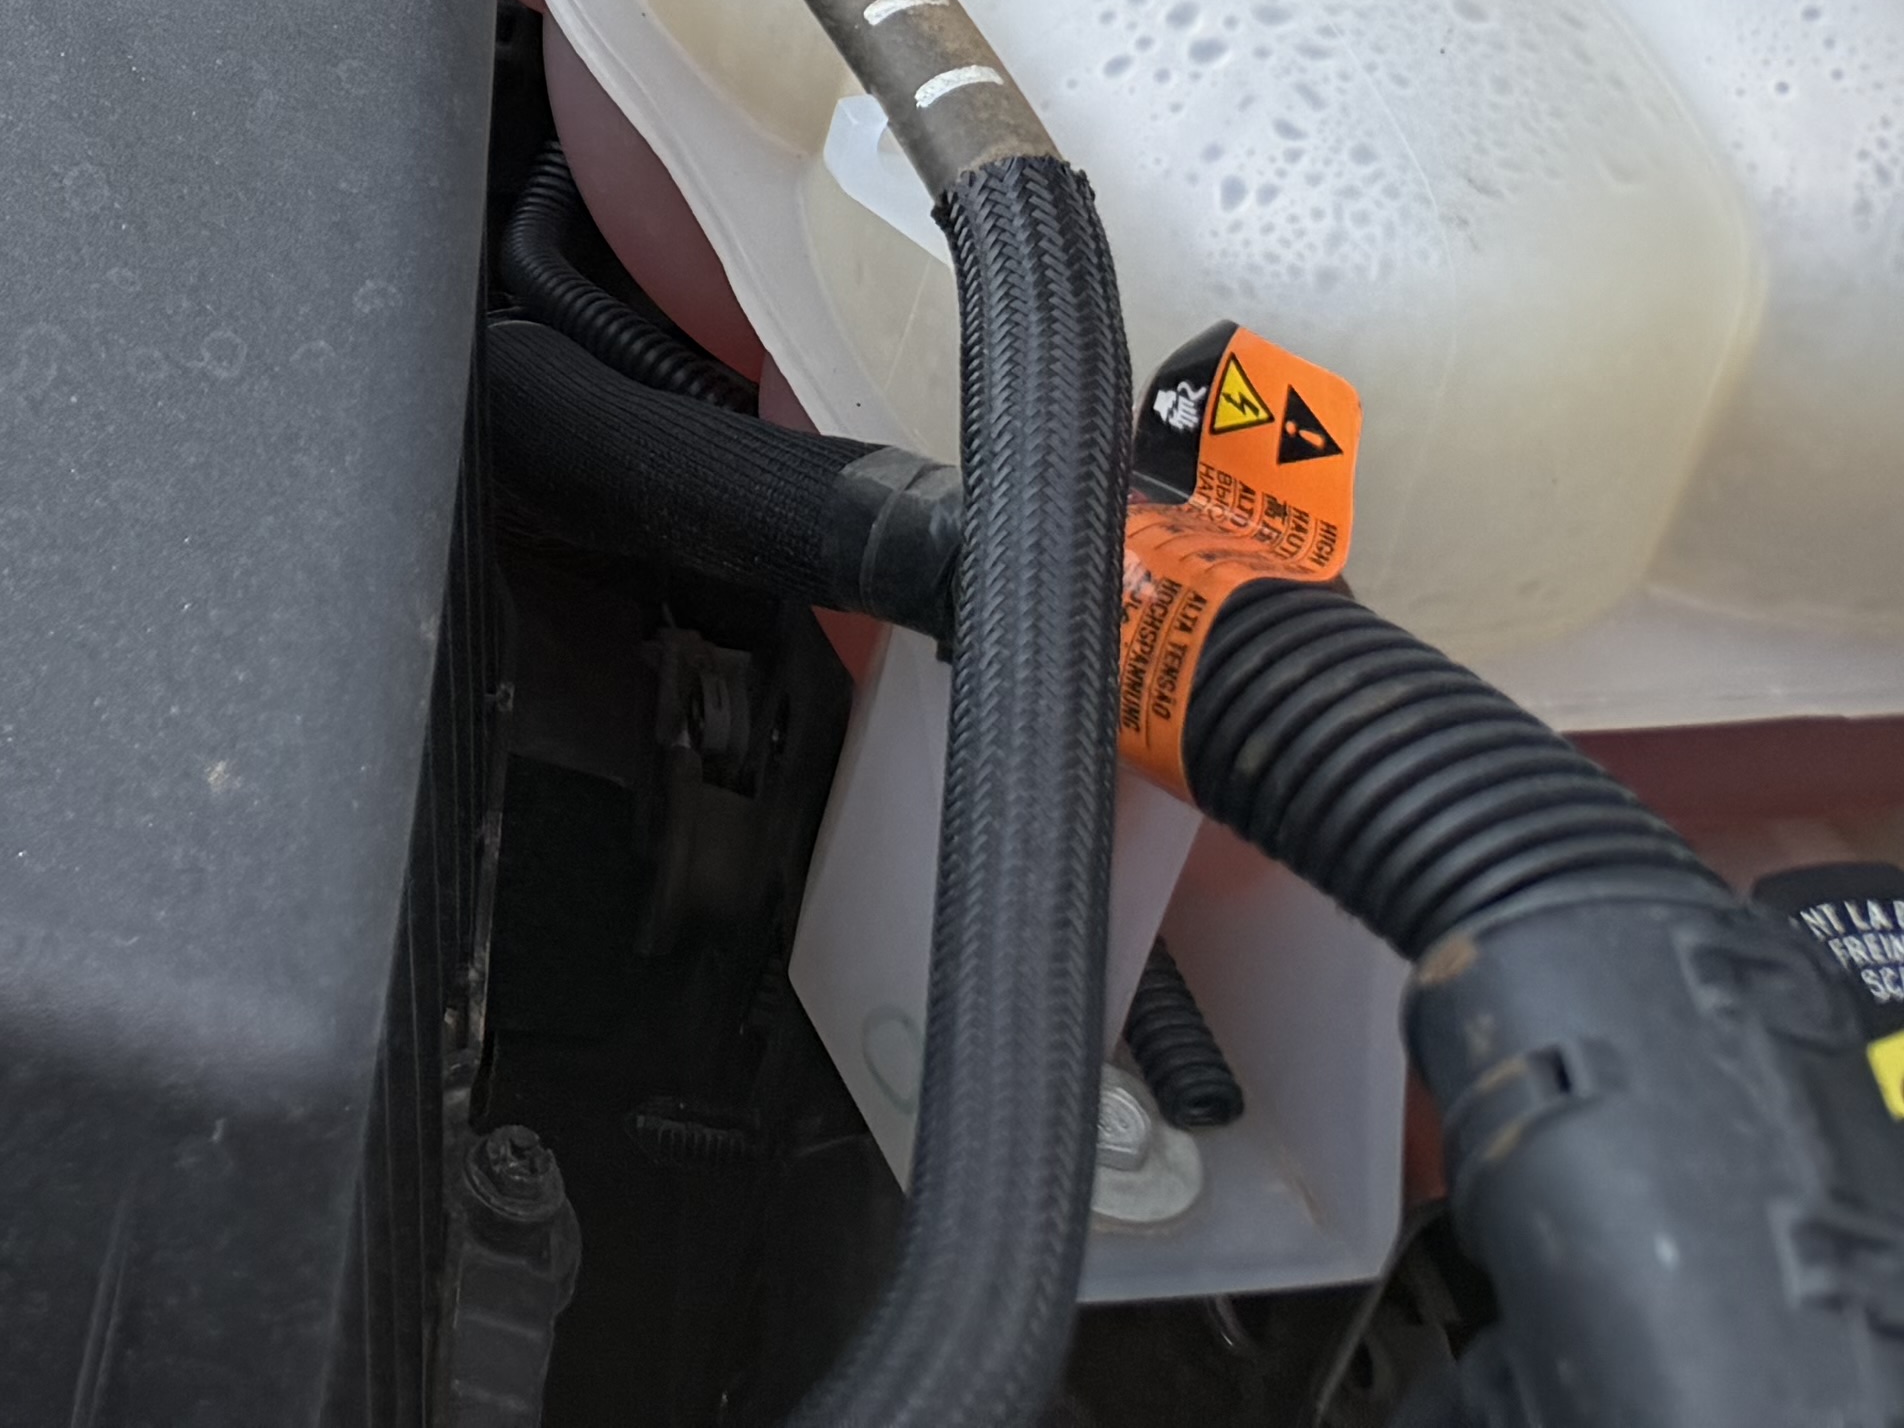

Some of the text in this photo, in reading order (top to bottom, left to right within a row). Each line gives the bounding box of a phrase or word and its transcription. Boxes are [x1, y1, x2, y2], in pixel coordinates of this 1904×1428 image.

[1308, 519, 1338, 567] HIGH
[1173, 590, 1208, 634] ALTA
[1121, 576, 1183, 733] HOCHSPANNUNG
